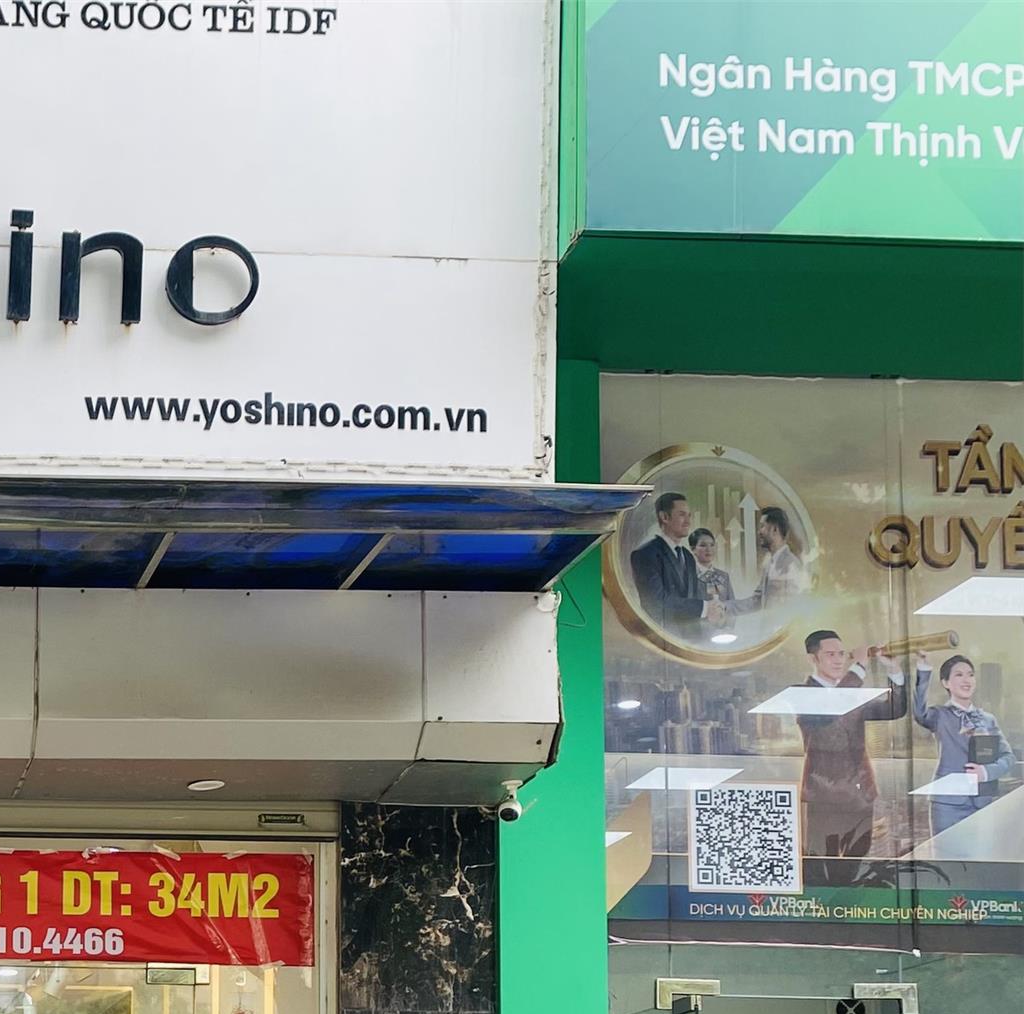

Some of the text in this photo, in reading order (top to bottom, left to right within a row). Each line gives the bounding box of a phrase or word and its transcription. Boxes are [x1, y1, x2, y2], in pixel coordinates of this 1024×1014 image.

[266, 7, 337, 35] IDF
[658, 52, 1024, 102] Ngân Hàng TMCP
[660, 115, 1024, 166] Việt Nam Thịnh V
[84, 392, 488, 433] www.yoshino.com.vn
[19, 871, 38, 915] 1
[62, 871, 132, 916] DT:
[148, 872, 280, 918] 34M2
[689, 903, 723, 917] DỊCH
[727, 904, 745, 918] VỤ
[833, 904, 876, 918] CHÍNH
[880, 904, 933, 920] CHUYÊN
